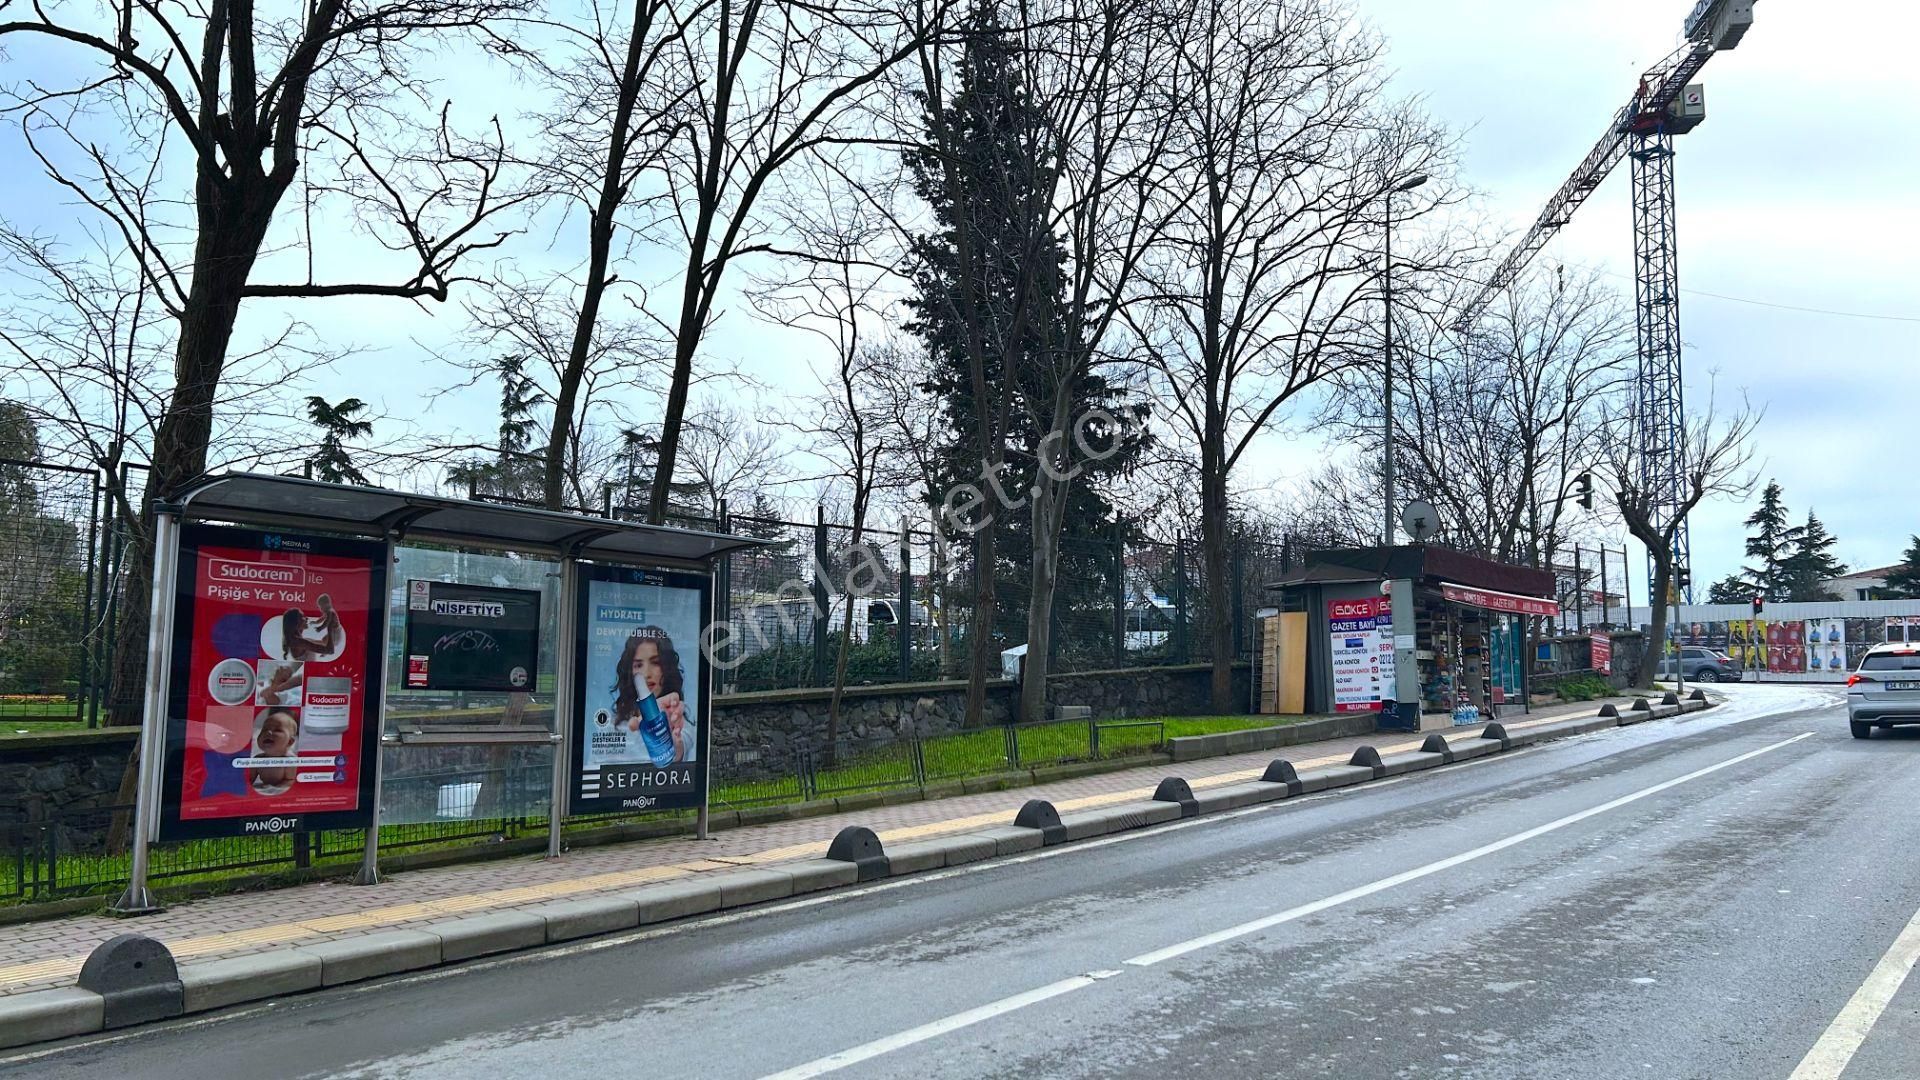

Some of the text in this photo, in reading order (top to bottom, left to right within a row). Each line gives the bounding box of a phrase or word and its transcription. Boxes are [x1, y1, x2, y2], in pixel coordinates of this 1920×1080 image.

[281, 540, 302, 548] MEDYA
[308, 572, 323, 584] ile
[208, 585, 305, 602] Pişiğe Yer Yok!
[436, 602, 502, 616] NİSPETİYE
[600, 609, 642, 620] HYDRATE
[1331, 621, 1357, 631] GAZETE
[596, 627, 623, 636] DEWY
[625, 628, 656, 638] BUBBLE
[607, 770, 691, 788] SEPHORA
[623, 796, 656, 808] PANOUT
[245, 817, 298, 832] PANOUT
